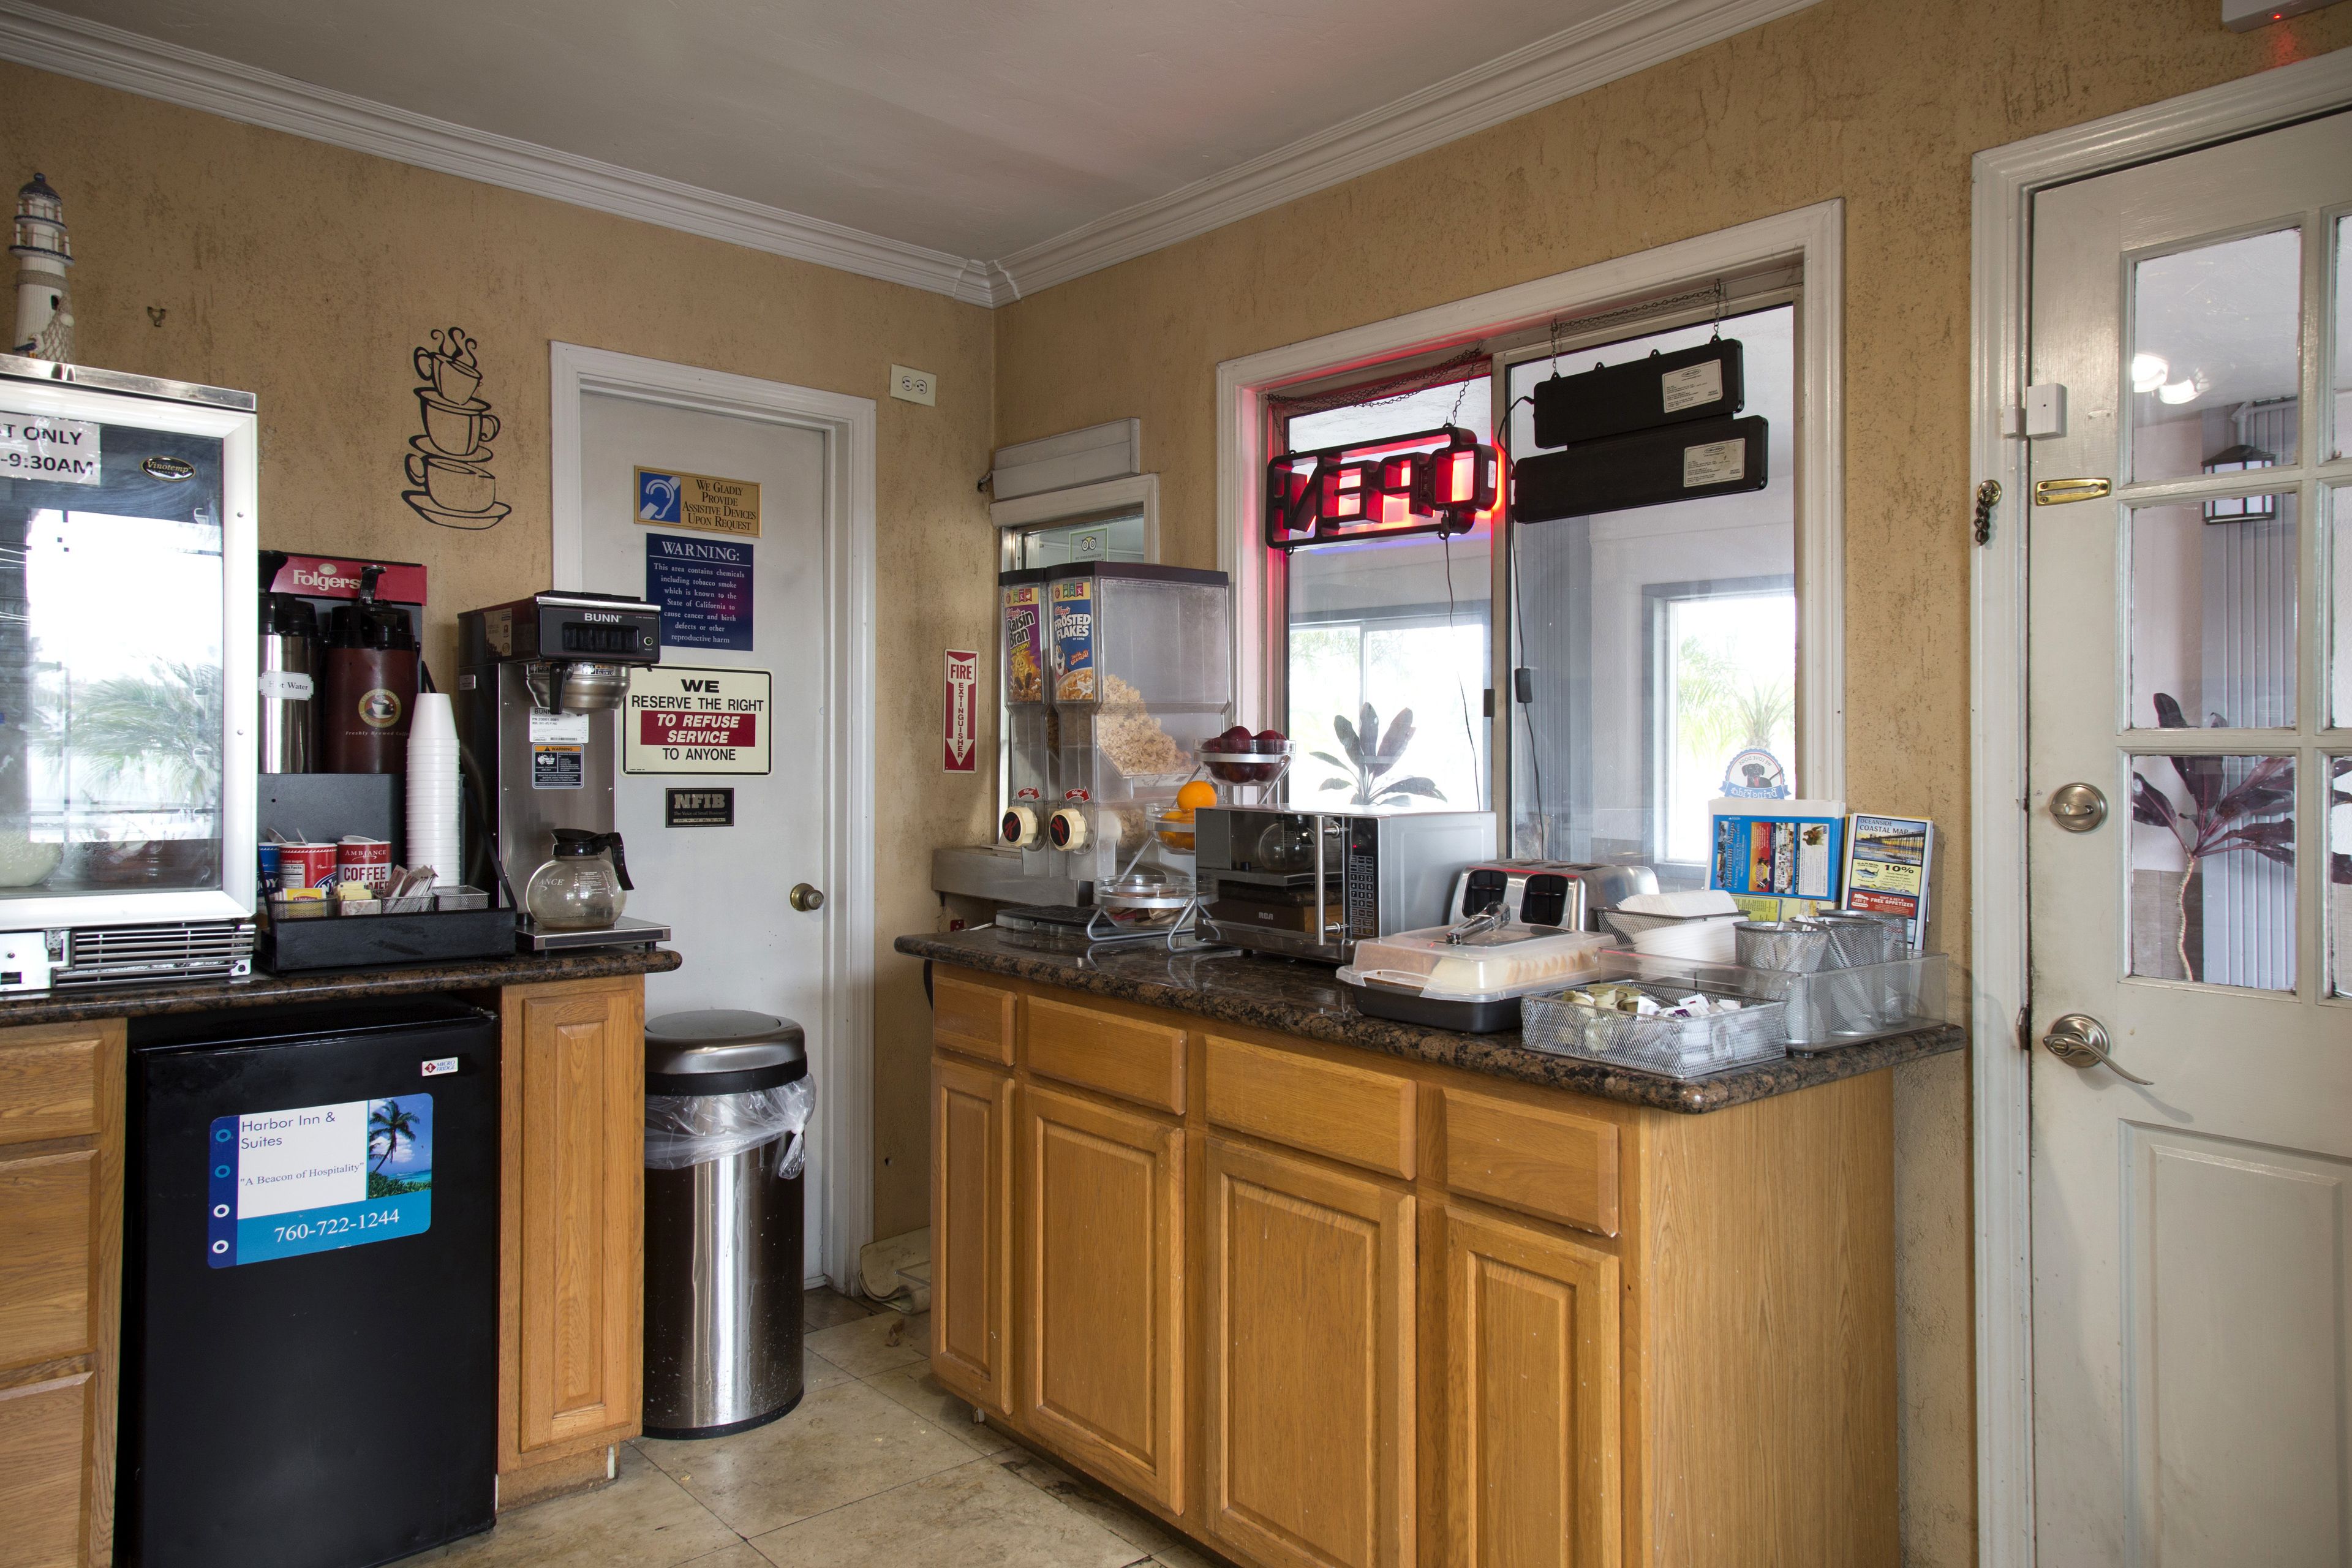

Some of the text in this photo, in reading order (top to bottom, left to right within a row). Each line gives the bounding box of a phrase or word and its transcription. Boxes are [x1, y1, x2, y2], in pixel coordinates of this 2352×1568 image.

[0, 421, 82, 445] T ONLY
[147, 461, 189, 473] Vinotemp
[696, 479, 744, 496] WE GLADLY
[702, 491, 738, 507] PROVIDE
[682, 500, 756, 520] ASSISTIVE DEVICES
[688, 512, 751, 530] UPON REQUEST
[662, 541, 740, 561] WARNING:
[654, 562, 668, 571] This
[716, 569, 745, 578] chemicals
[293, 569, 362, 592] Folgers
[661, 575, 690, 586] including
[665, 587, 682, 595] which
[694, 589, 715, 598] known
[667, 598, 683, 606] State
[695, 600, 726, 610] California
[584, 612, 619, 623] BUNN
[1007, 610, 1036, 634] Raisin
[1054, 613, 1091, 631] FROSTED
[671, 635, 711, 644] reproductive
[1008, 627, 1030, 649] Bran
[1056, 625, 1089, 641] FLAKES
[950, 664, 972, 680] FIRE
[287, 682, 309, 690] Water
[680, 679, 720, 693] WE
[631, 695, 764, 712] RESERVE THE RIGHT
[657, 714, 741, 728] TO REFUSE
[667, 730, 729, 744] SERVICE
[662, 747, 736, 761] TO ANYONE
[674, 793, 726, 809] NFIB
[1859, 824, 1890, 834] COASTAL
[345, 850, 387, 858] AMBIANCE
[344, 866, 386, 881] COFFEE
[1885, 864, 1914, 874] 10%
[1259, 911, 1273, 920] RCA
[242, 1112, 336, 1133] Harbor Inn &
[241, 1136, 282, 1150] Suites
[257, 1174, 293, 1185] Beacon
[296, 1170, 307, 1179] of
[309, 1162, 364, 1178] Hospitality"
[274, 1208, 400, 1243] 760-722-1244
